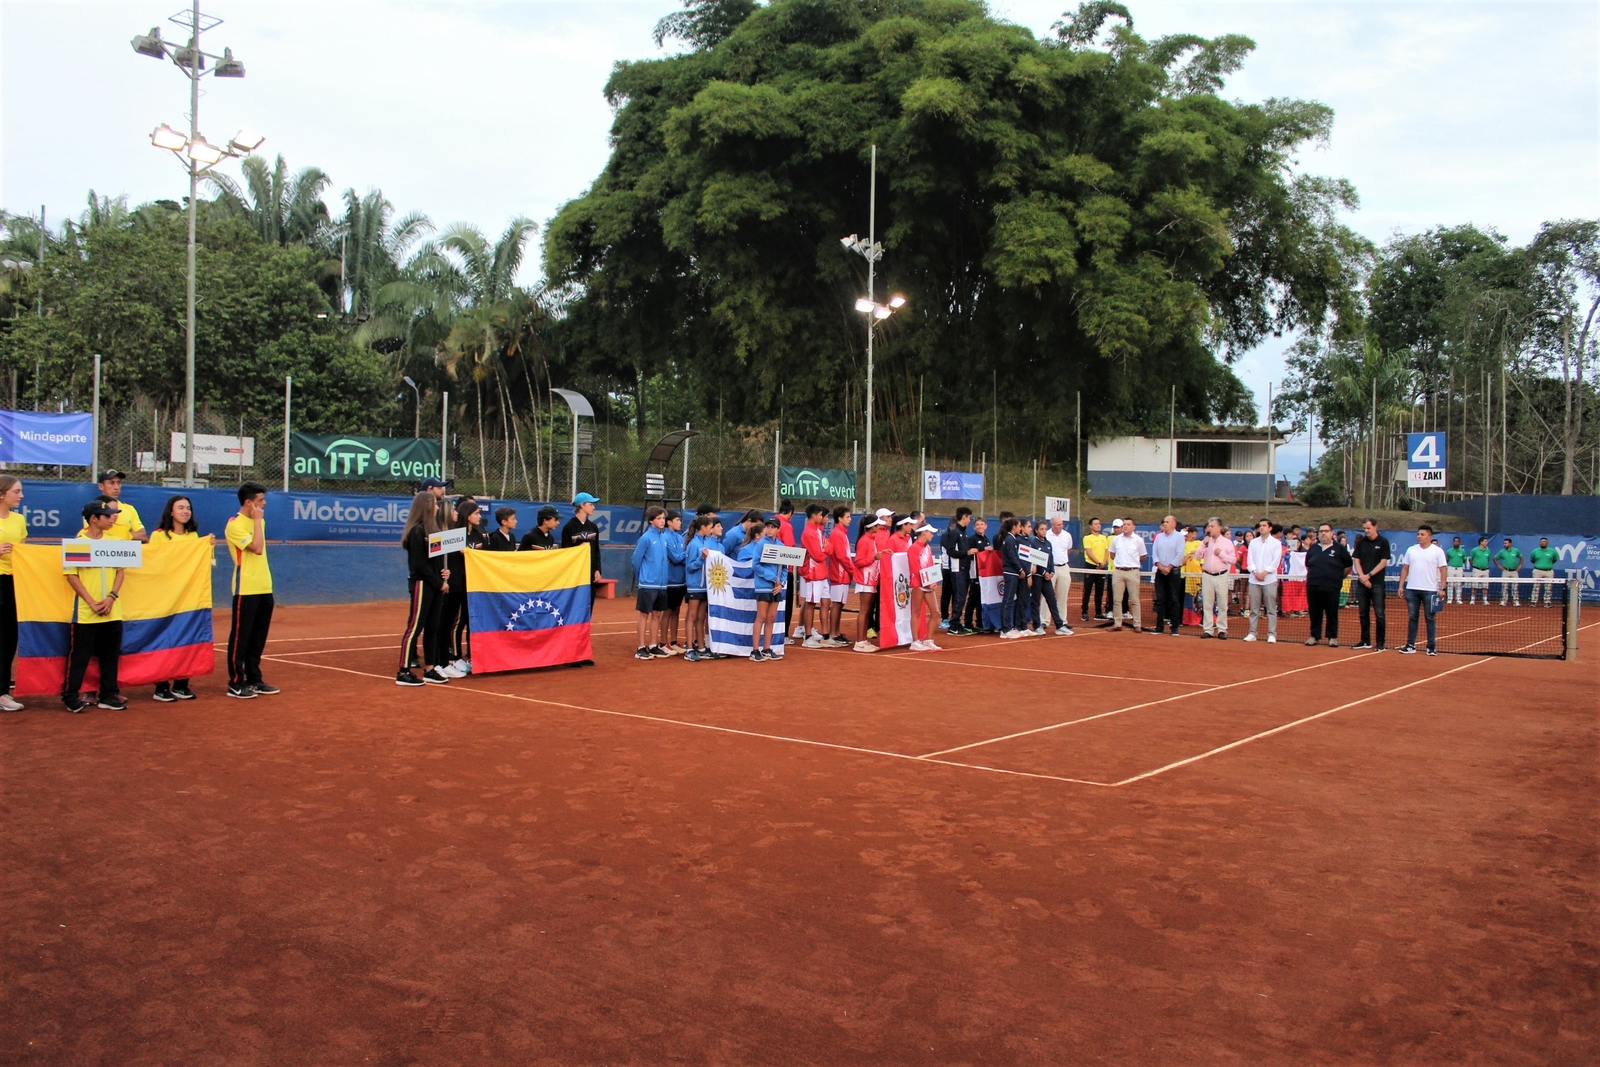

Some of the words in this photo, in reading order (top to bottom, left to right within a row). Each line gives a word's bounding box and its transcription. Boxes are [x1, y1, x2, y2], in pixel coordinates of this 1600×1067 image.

[20, 431, 87, 444] Mindeporte
[1411, 436, 1440, 468] 4
[294, 456, 320, 474] an
[330, 452, 371, 475] ITF
[390, 459, 441, 478] event
[781, 483, 795, 495] an
[799, 480, 819, 496] ITF
[829, 485, 856, 499] event
[442, 536, 464, 546] VENEZUELA
[94, 550, 137, 558] COLOMBIA
